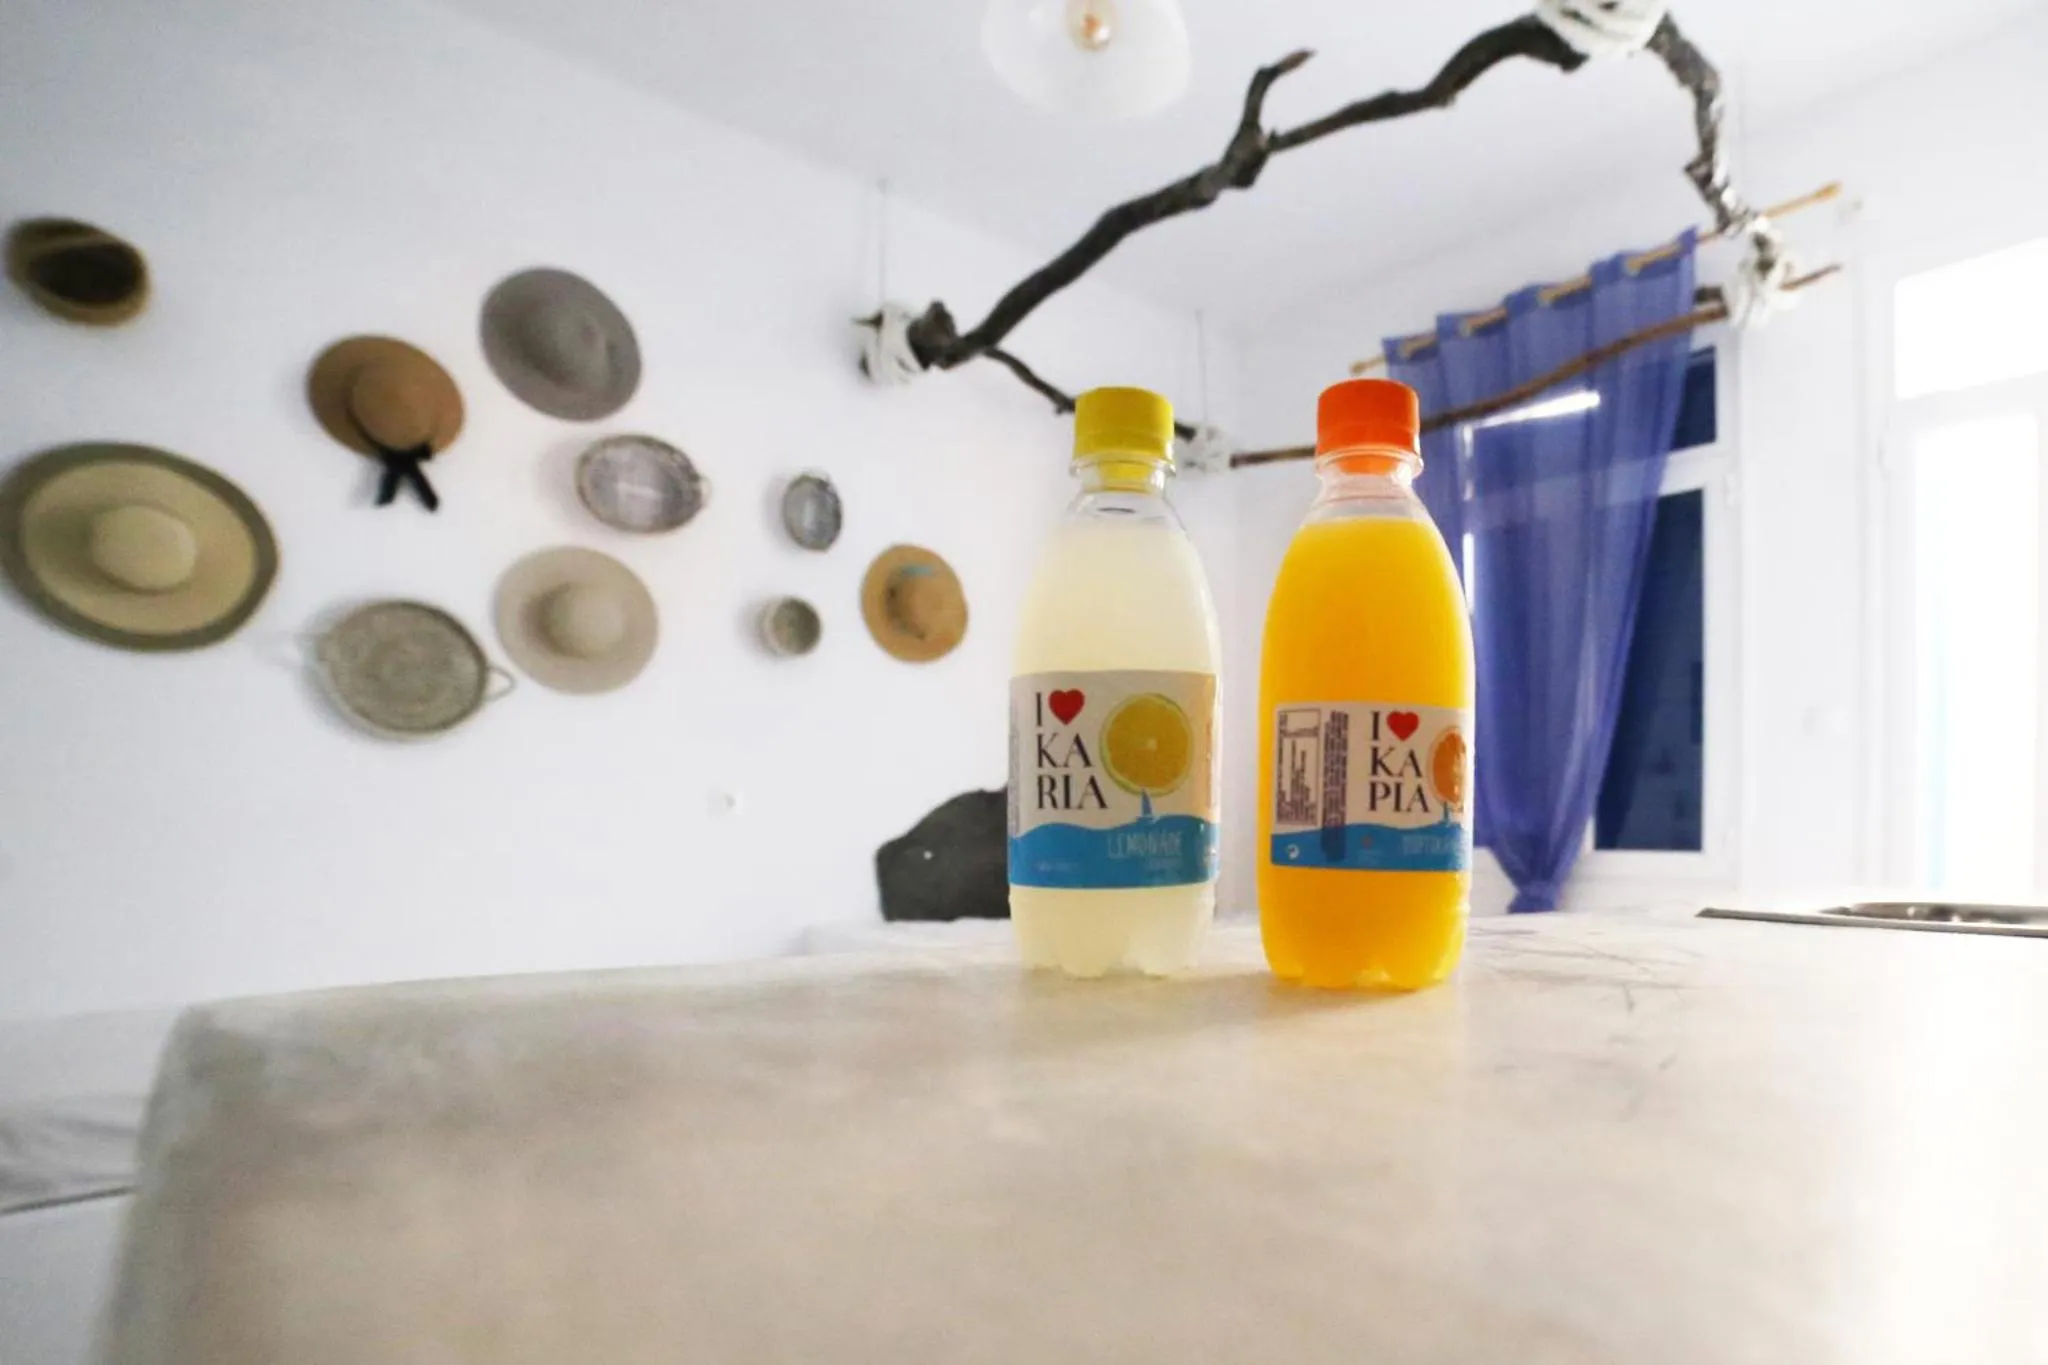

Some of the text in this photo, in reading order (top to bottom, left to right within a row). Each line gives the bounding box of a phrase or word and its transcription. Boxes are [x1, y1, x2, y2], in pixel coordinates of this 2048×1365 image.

[1035, 691, 1043, 728] I
[1370, 710, 1381, 742] I
[1036, 732, 1095, 769] KA
[1369, 745, 1423, 779] KA
[1036, 773, 1109, 811] RIA
[1367, 781, 1431, 814] PIA
